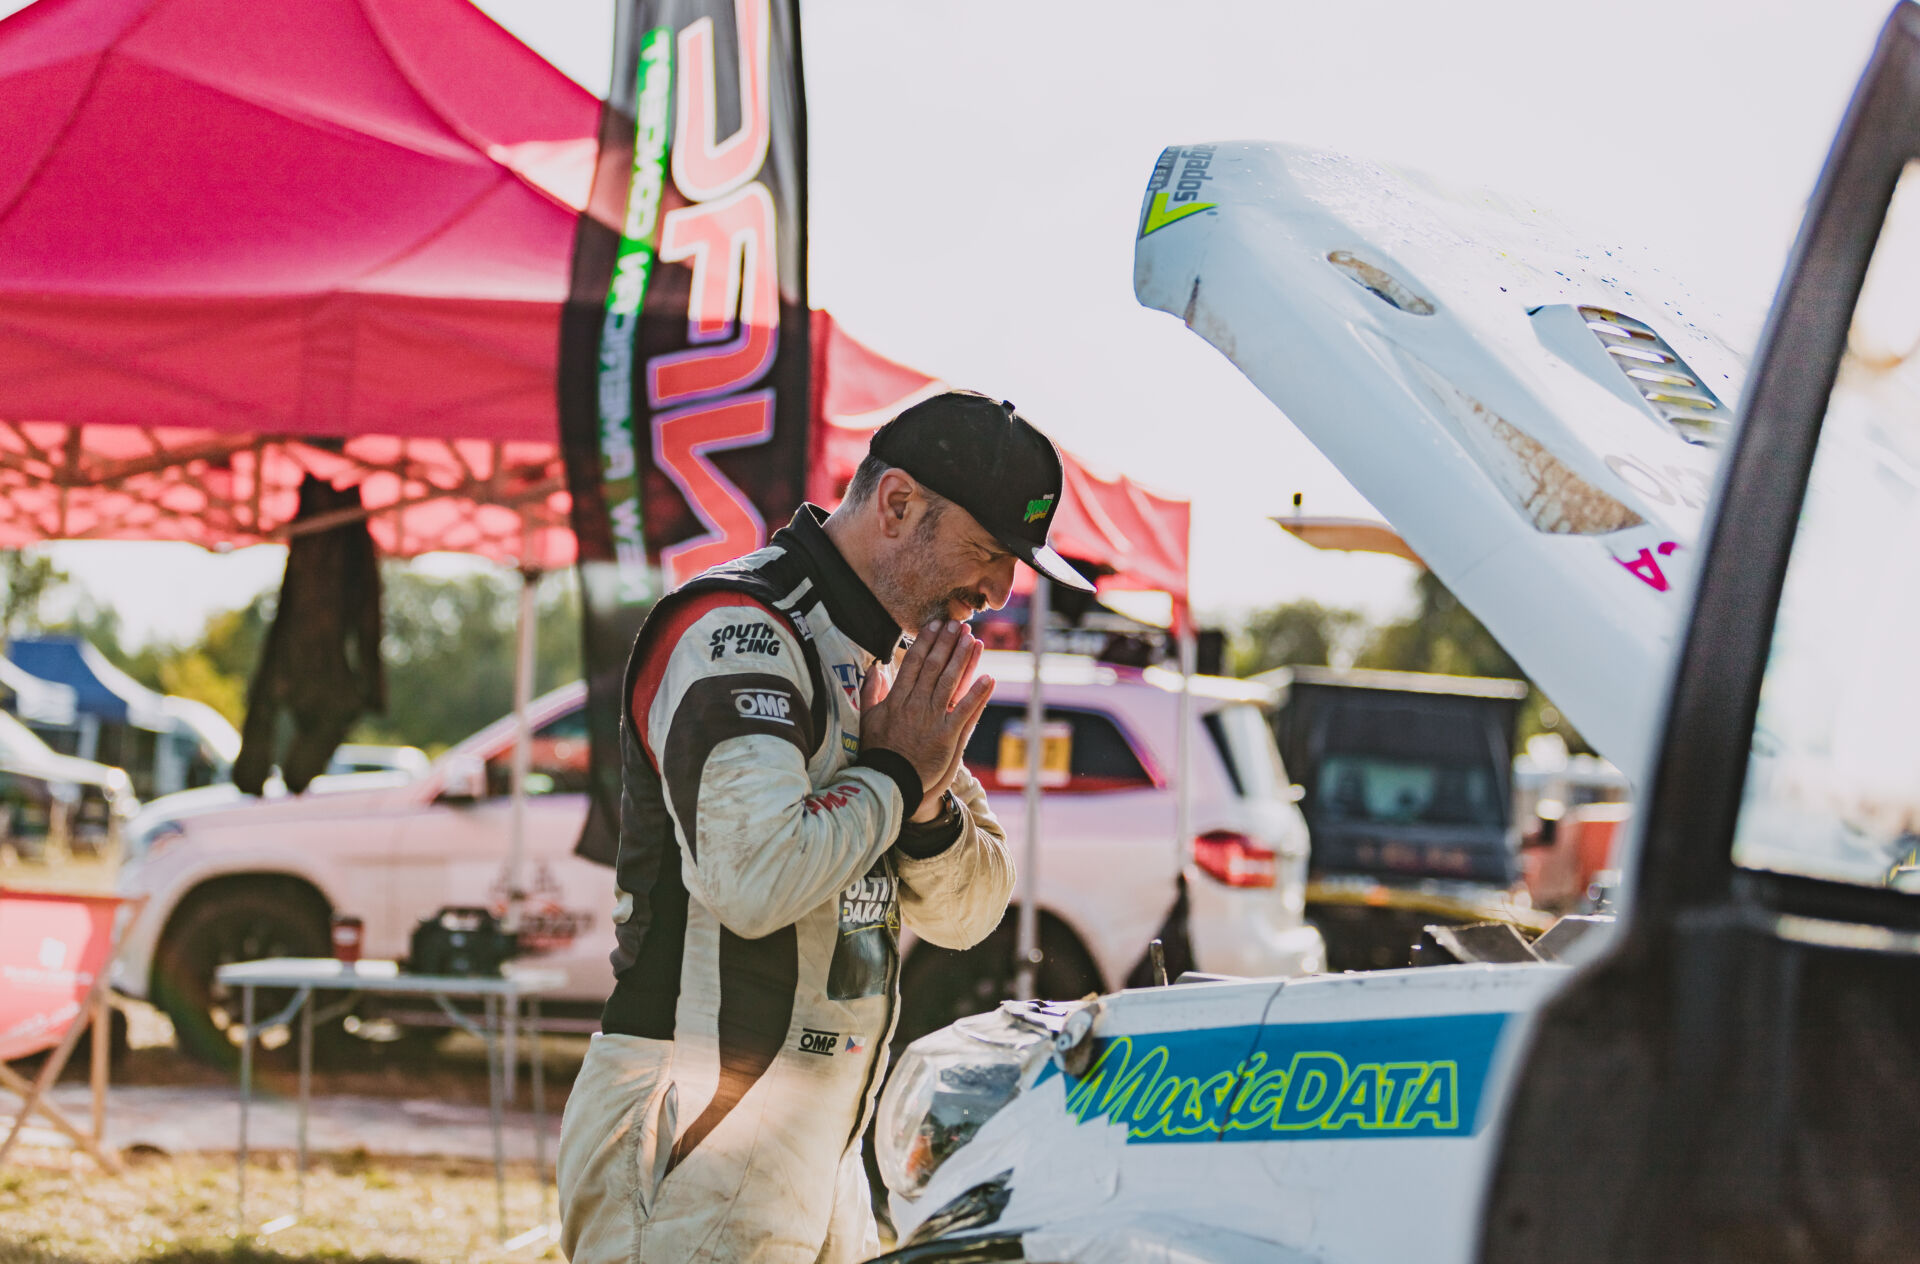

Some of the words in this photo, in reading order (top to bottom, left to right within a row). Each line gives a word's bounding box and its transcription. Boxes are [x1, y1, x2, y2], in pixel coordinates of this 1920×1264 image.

[709, 622, 775, 647] SOUTH
[734, 693, 791, 719] OMP
[800, 1033, 838, 1053] OMP
